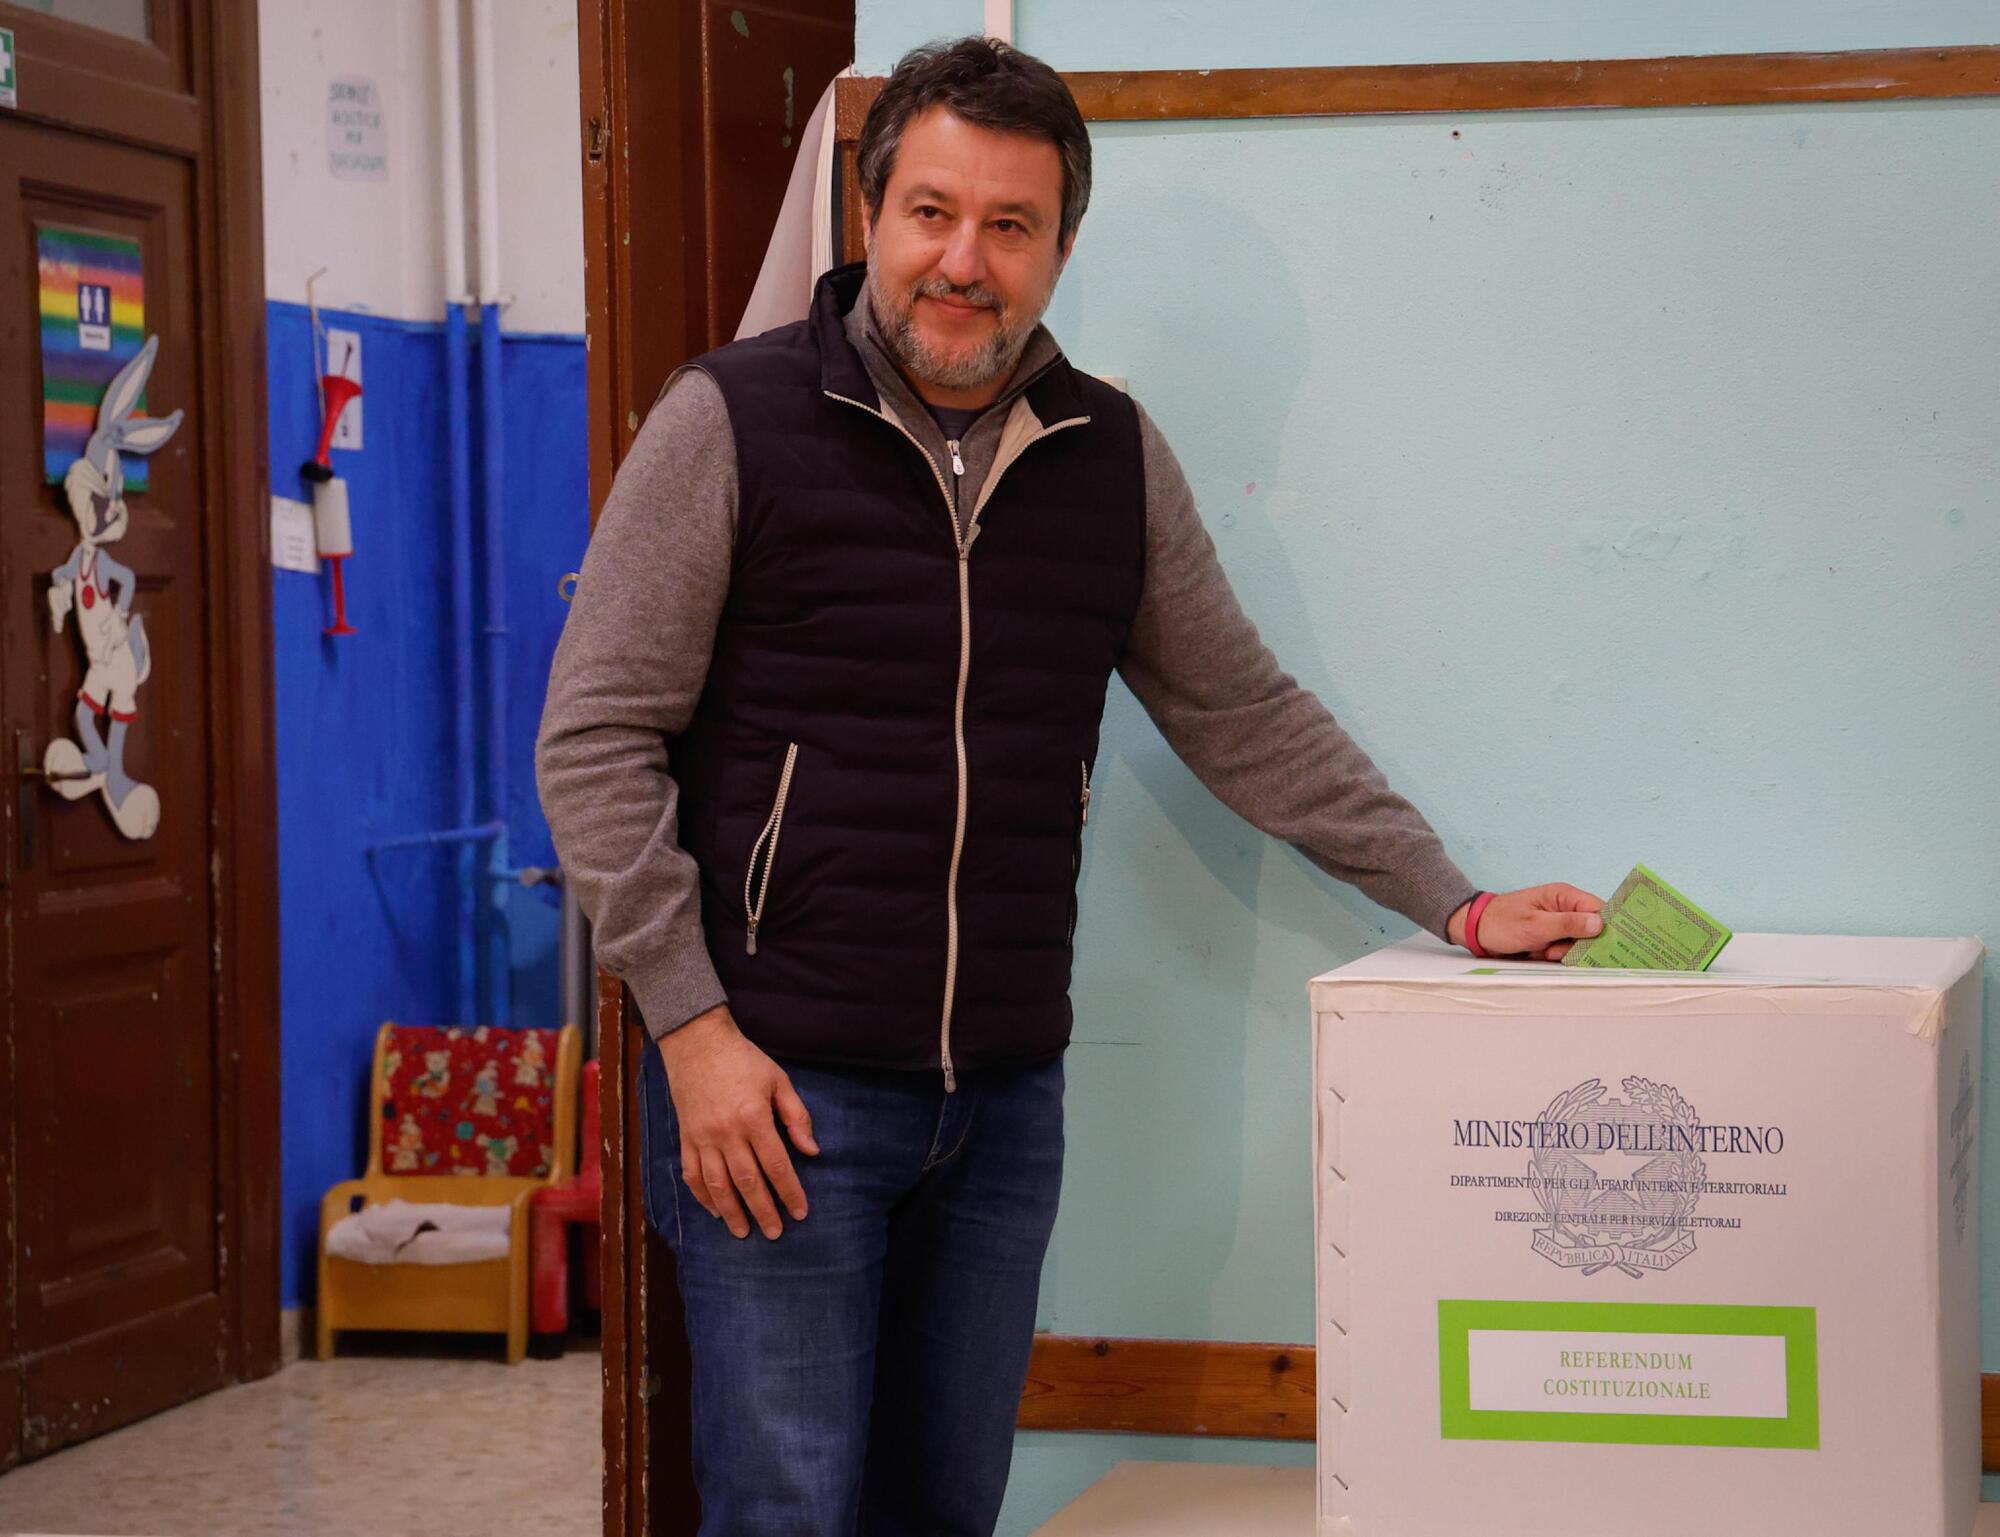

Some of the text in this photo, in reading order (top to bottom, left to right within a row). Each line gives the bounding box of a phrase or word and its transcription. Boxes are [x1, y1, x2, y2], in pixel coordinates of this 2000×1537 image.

[1453, 1119, 1784, 1154] MINISTERO DELL'INTERNO
[1451, 1176, 1787, 1195] DIPARTIMENTO PER GLI AFFARI INTERNI E TERRITORIALI
[1495, 1211, 1551, 1223] DIREZIONE
[1553, 1212, 1607, 1224] CENTRALE
[1610, 1214, 1628, 1225] PER
[1636, 1216, 1675, 1227] SERVIZI
[1678, 1217, 1741, 1228] ELETTORALI
[1628, 1242, 1692, 1266] ITALIANA
[1560, 1350, 1693, 1370] REFERENDUM
[1543, 1379, 1711, 1399] COSTITUZIONALE
